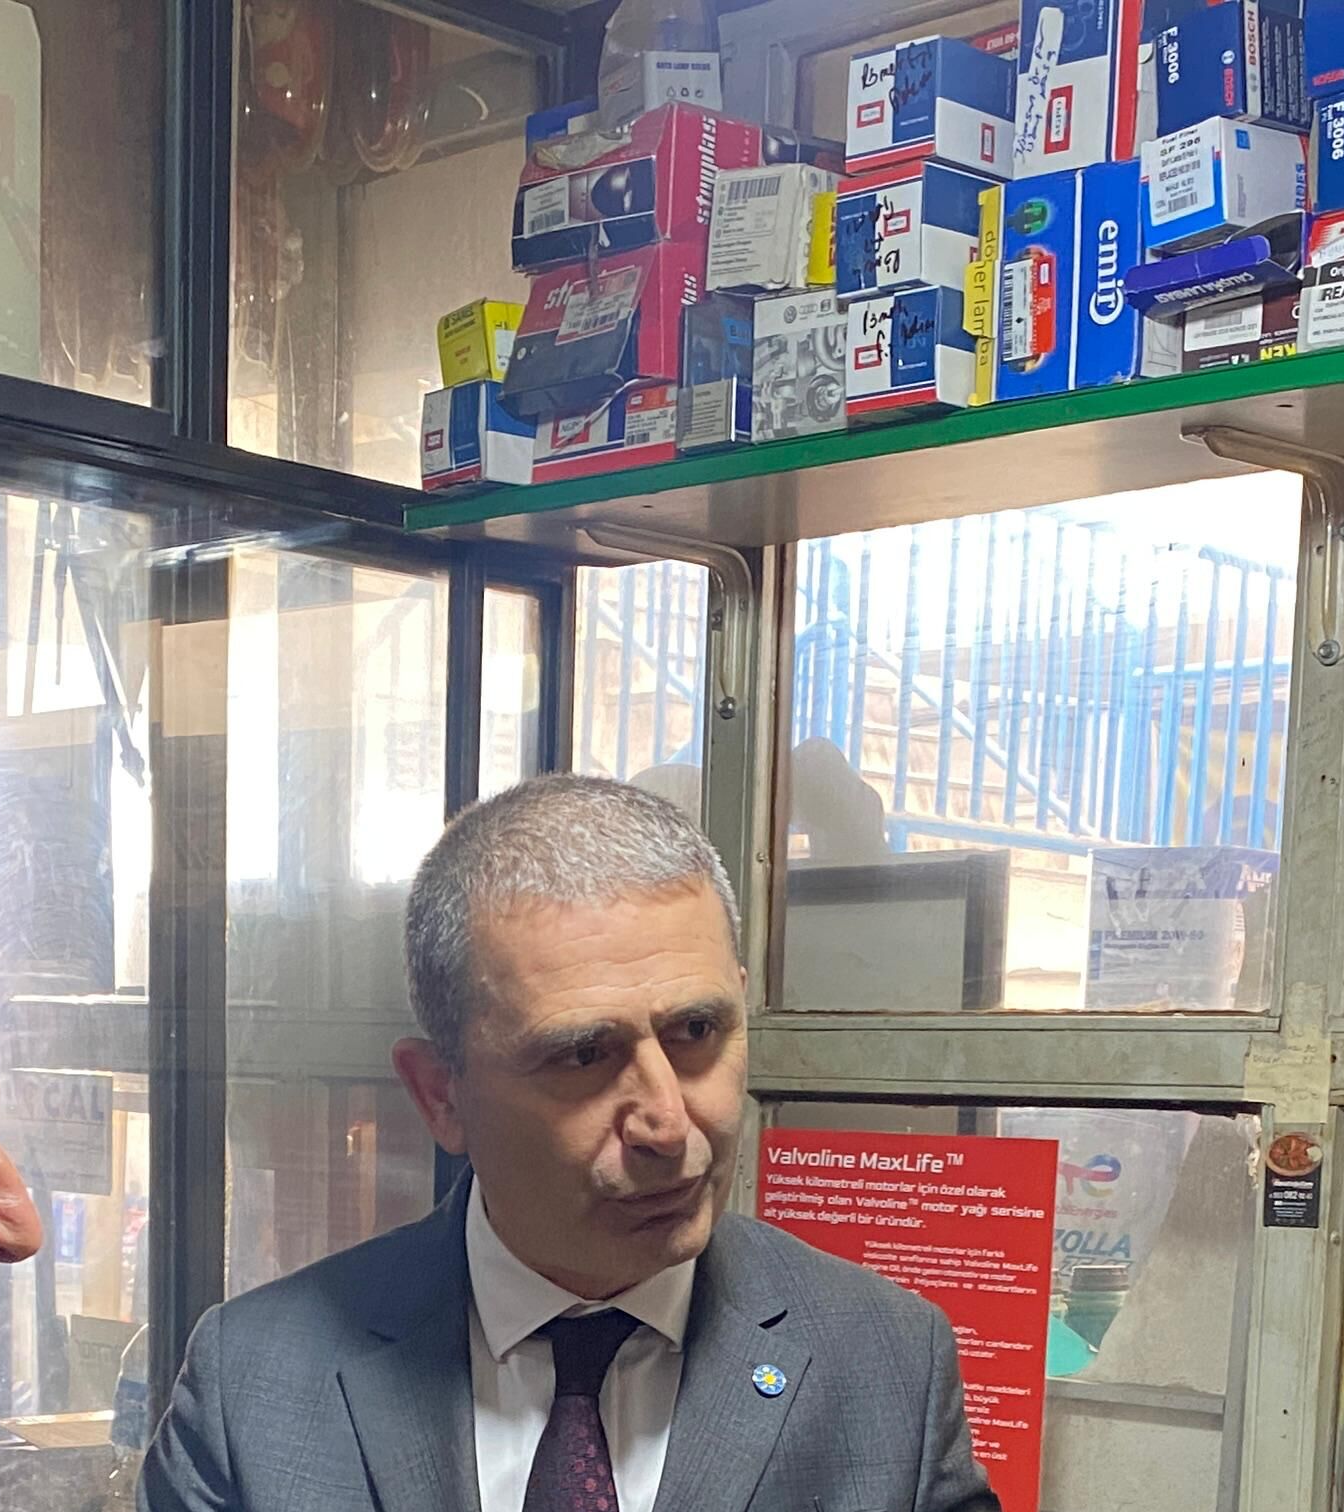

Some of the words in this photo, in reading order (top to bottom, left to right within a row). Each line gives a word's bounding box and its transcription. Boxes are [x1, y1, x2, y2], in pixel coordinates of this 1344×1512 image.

[1245, 10, 1258, 66] BOSCH
[767, 1147, 856, 1170] Valvoline
[765, 1173, 804, 1187] Yüksek
[805, 1175, 864, 1190] kilometreli
[865, 1179, 918, 1193] motorlar
[918, 1182, 939, 1197] için
[940, 1183, 967, 1196] özel
[967, 1186, 1007, 1199] olarak
[776, 1208, 817, 1222] yüksek
[857, 1214, 874, 1225] bir
[875, 1215, 927, 1229] üründür.
[827, 1195, 853, 1206] olan
[921, 1201, 959, 1213] motor
[961, 1202, 988, 1218] yağı
[990, 1205, 1045, 1219] serisine
